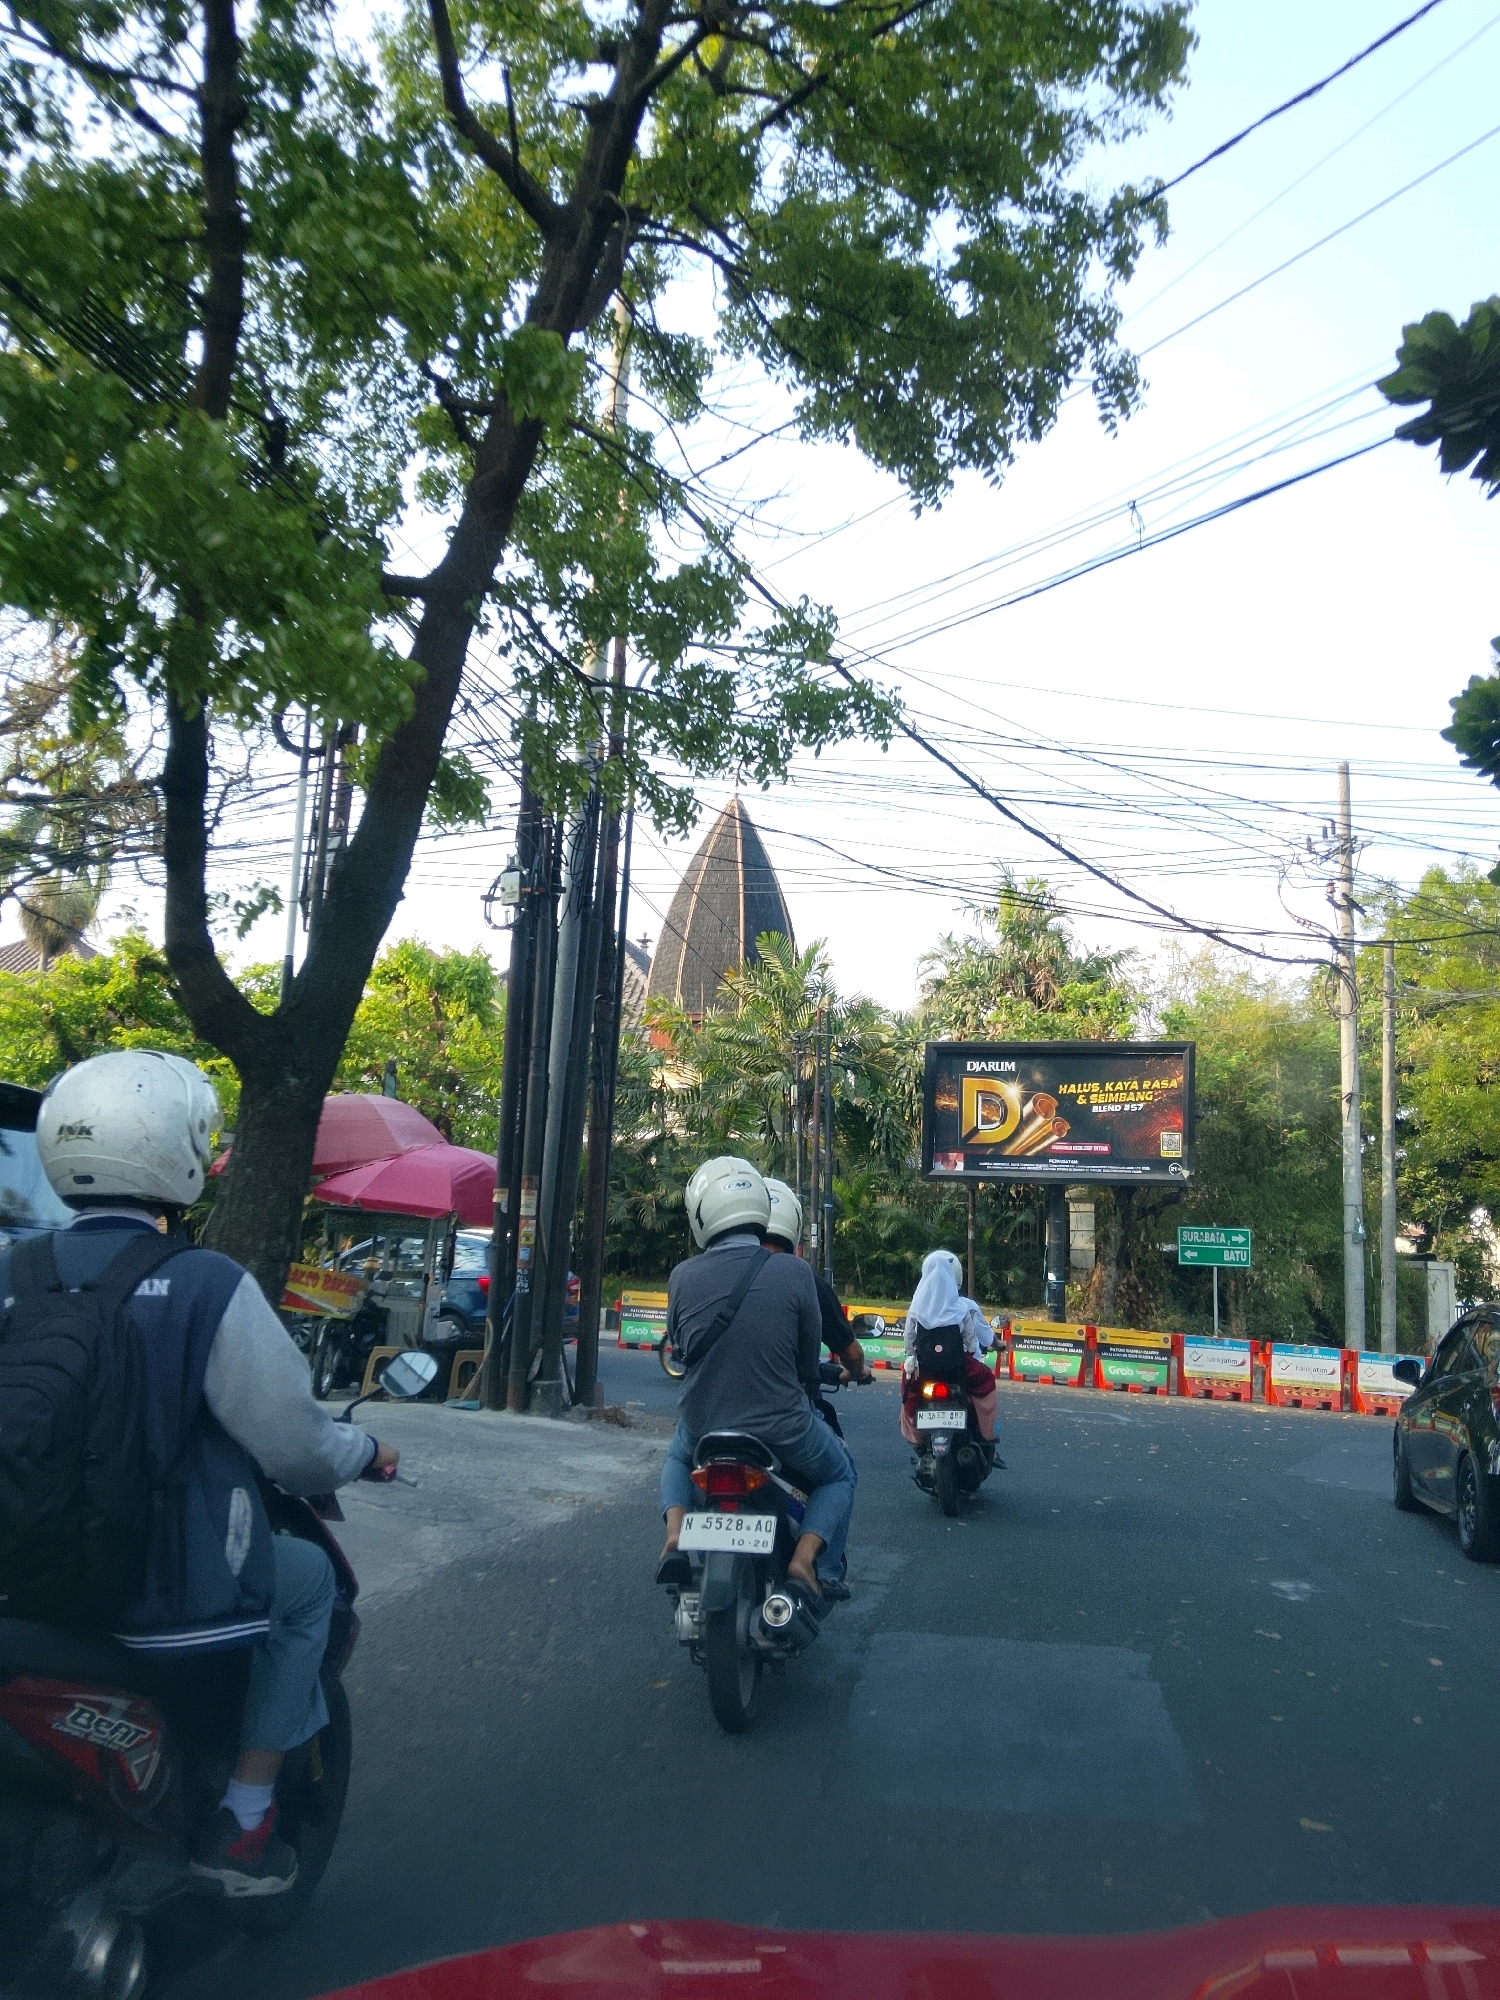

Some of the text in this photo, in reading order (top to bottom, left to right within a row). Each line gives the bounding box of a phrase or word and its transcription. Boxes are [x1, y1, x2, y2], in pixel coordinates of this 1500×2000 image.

[966, 1061, 1016, 1072] DJARUM
[1058, 1078, 1178, 1095] HALUS, KAYA RASA
[1076, 1091, 1153, 1104] & SEIMBANG
[1092, 1103, 1144, 1112] BLEND #57
[1223, 1250, 1247, 1262] BATU
[626, 1326, 648, 1336] Grab
[1020, 1357, 1047, 1368] Grab
[1108, 1365, 1134, 1376] Grab
[685, 1517, 694, 1530] N
[705, 1517, 744, 1531] 5528
